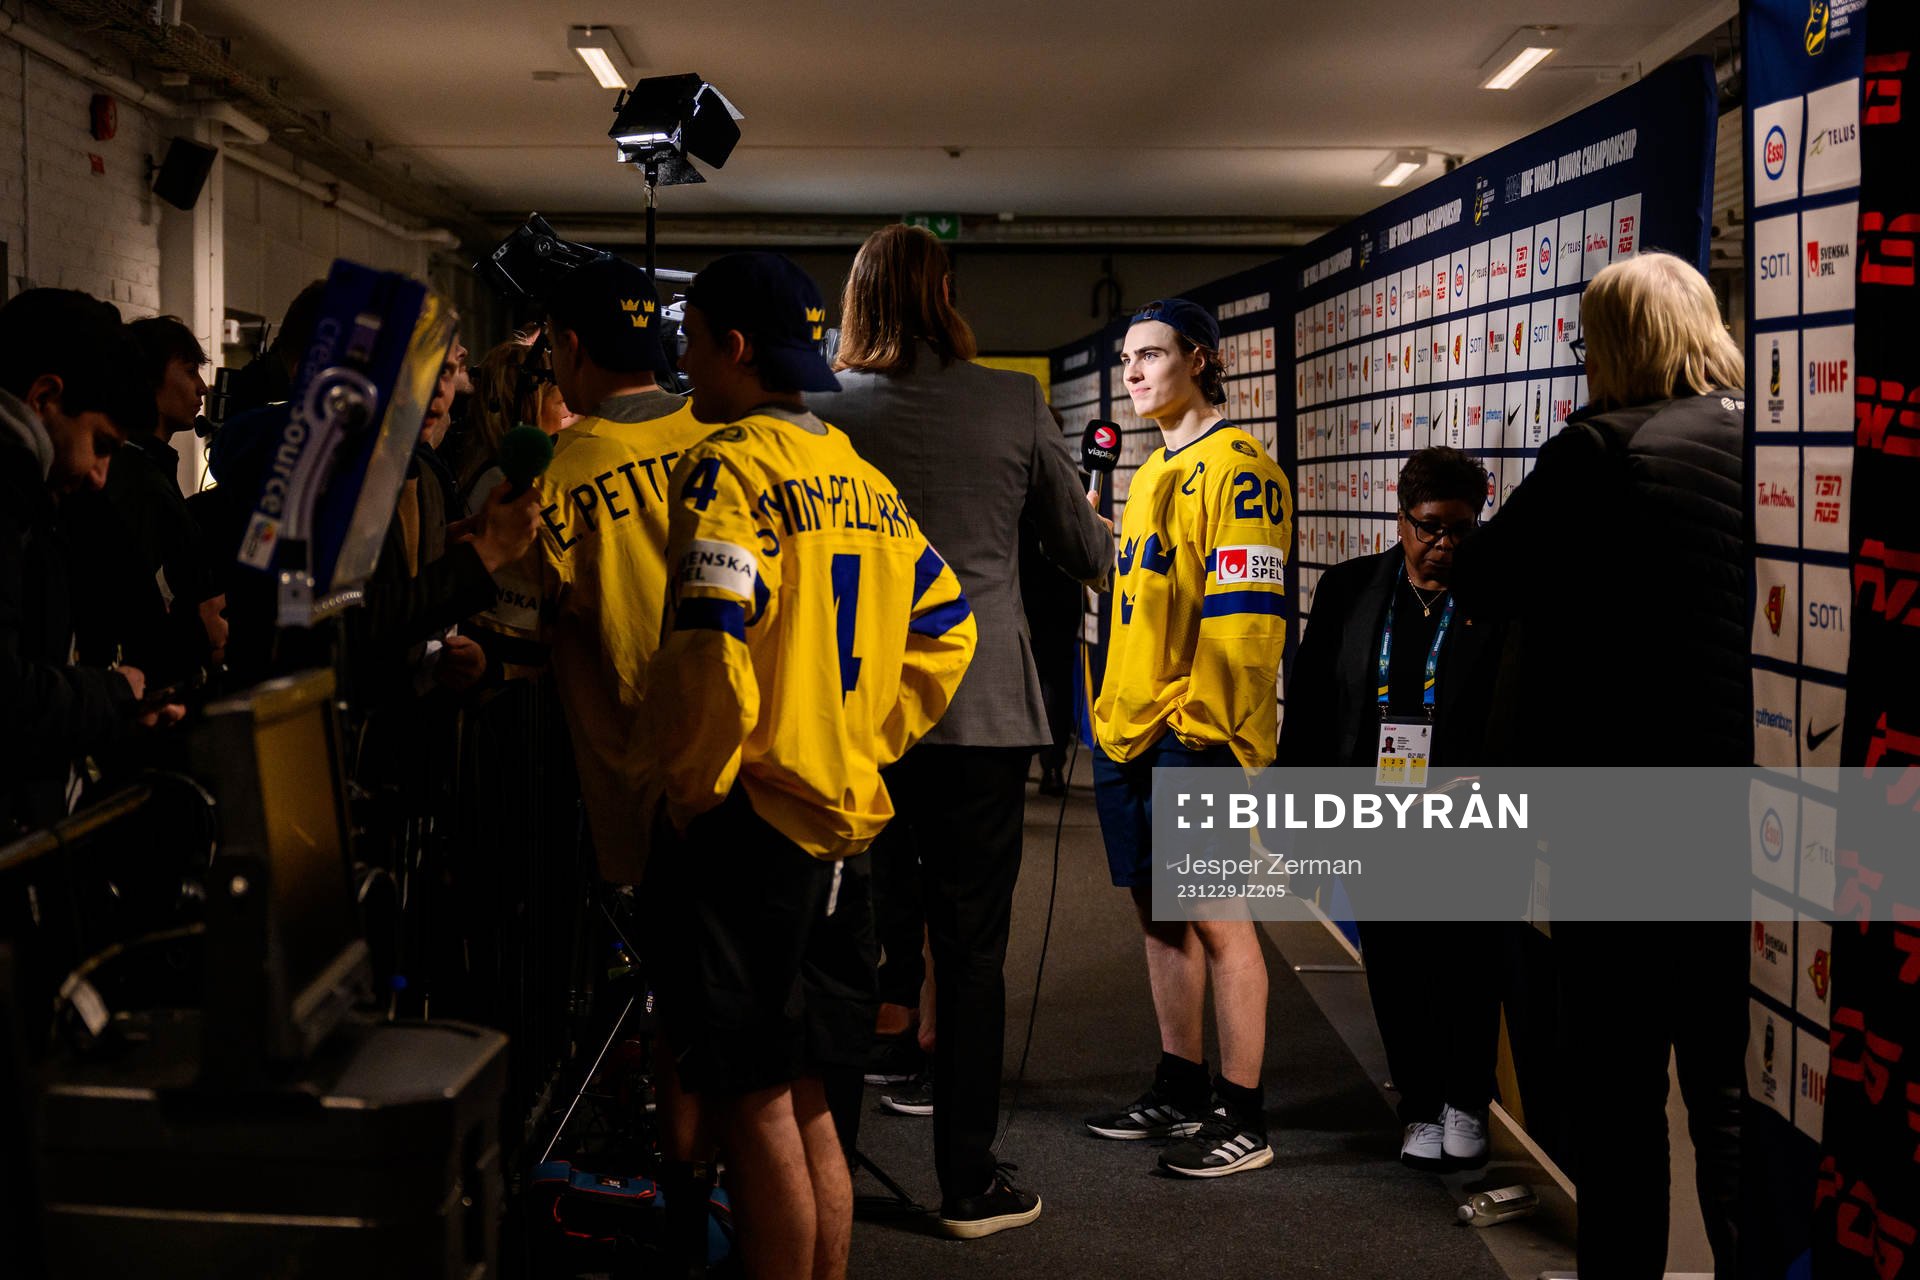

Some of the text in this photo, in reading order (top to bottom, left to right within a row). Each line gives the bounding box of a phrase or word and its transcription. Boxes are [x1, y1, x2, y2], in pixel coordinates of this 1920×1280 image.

[1828, 124, 1856, 146] TELUS
[1534, 160, 1556, 193] WORLD
[1556, 149, 1581, 184] JUNIOR
[1582, 128, 1637, 175] CHAMPIONSHIP
[1820, 244, 1850, 259] SVENSKA
[1760, 253, 1791, 281] SOTI
[1820, 262, 1836, 277] SPEL
[1533, 325, 1549, 343] SOTI
[1817, 360, 1849, 394] IIHF
[1088, 447, 1116, 461] viaplay
[682, 457, 721, 512] 4
[1815, 474, 1843, 496] TSN
[1234, 471, 1284, 526] 20
[1252, 555, 1283, 569] SVEN
[1252, 567, 1282, 580] SPEL
[1808, 602, 1844, 632] SOTI
[1819, 845, 1834, 866] TEL
